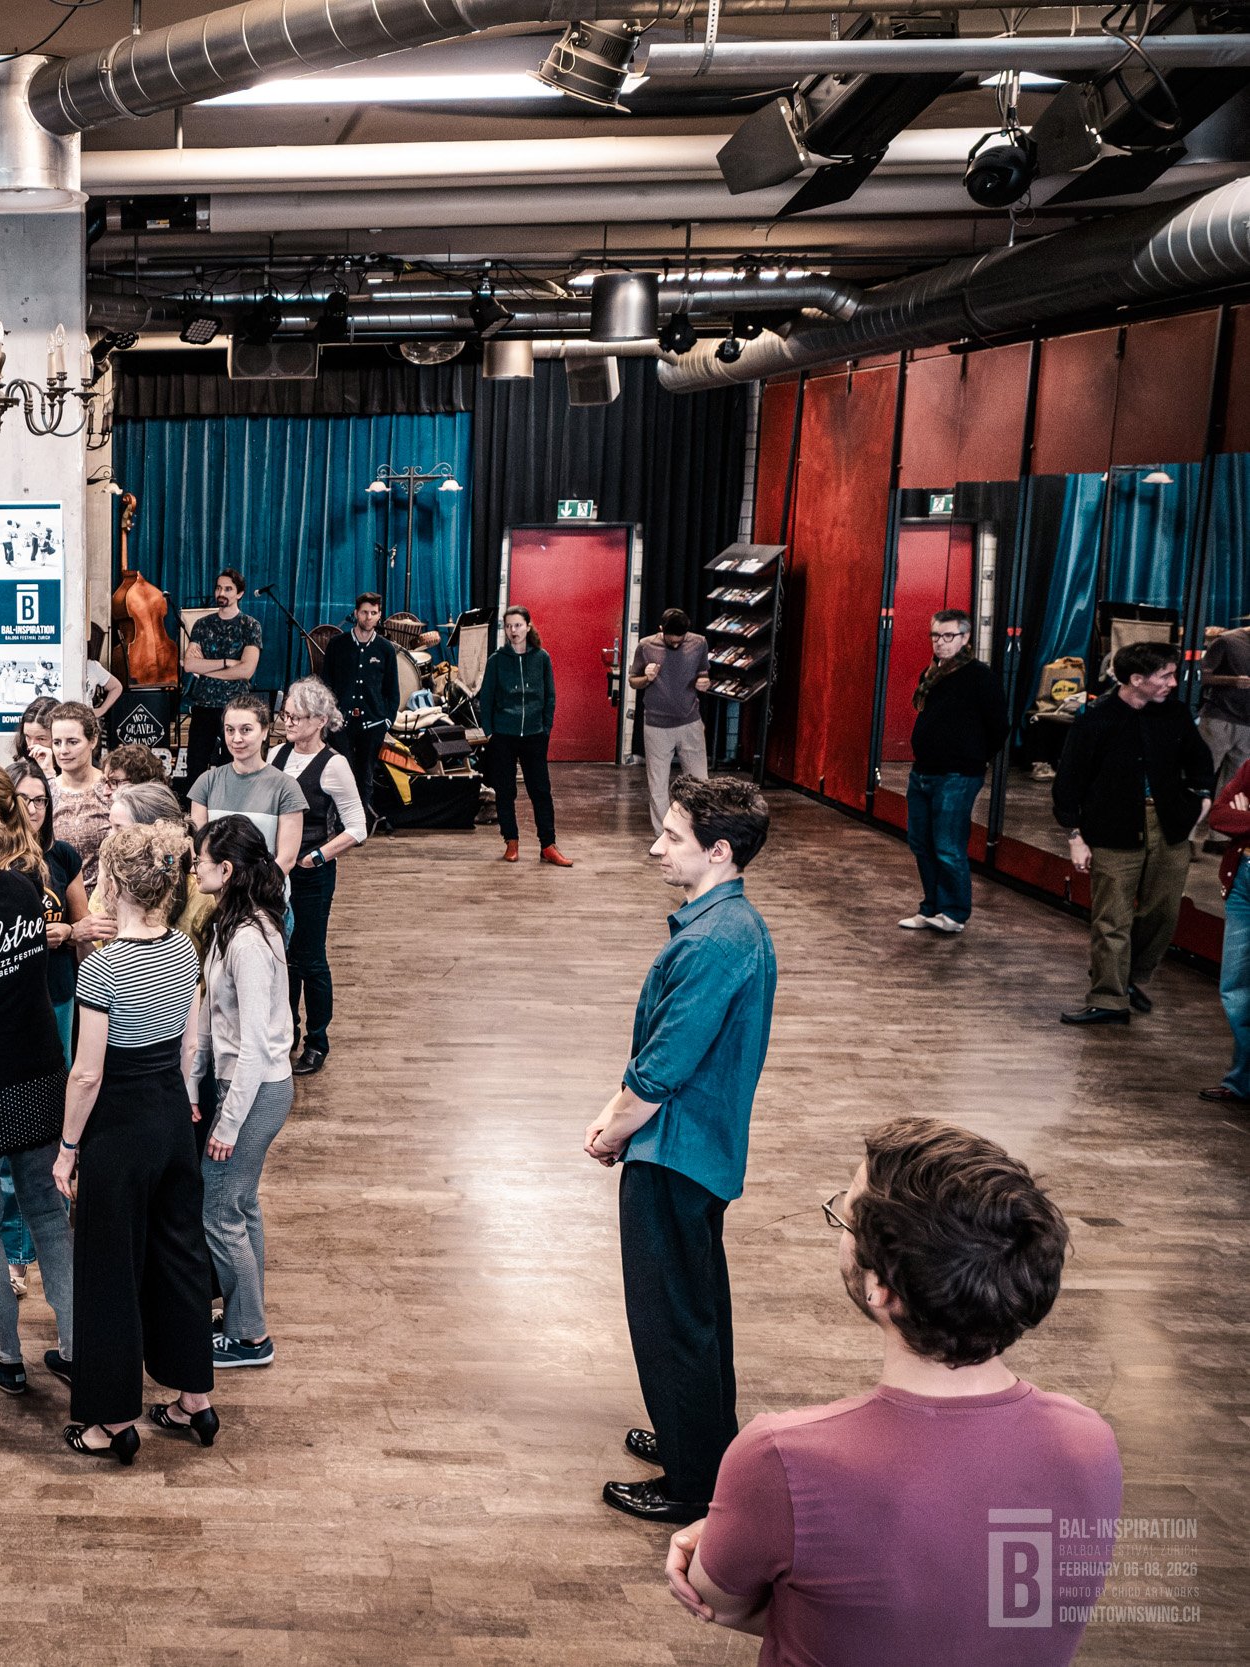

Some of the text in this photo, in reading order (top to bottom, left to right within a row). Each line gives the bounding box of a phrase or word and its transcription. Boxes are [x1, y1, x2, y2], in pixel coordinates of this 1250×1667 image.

[22, 595, 35, 620] B
[1, 625, 55, 635] BAL-INSPIRATION
[132, 713, 150, 723] HOT
[125, 723, 156, 735] GRAVEL
[14, 944, 44, 962] FESTIVAL
